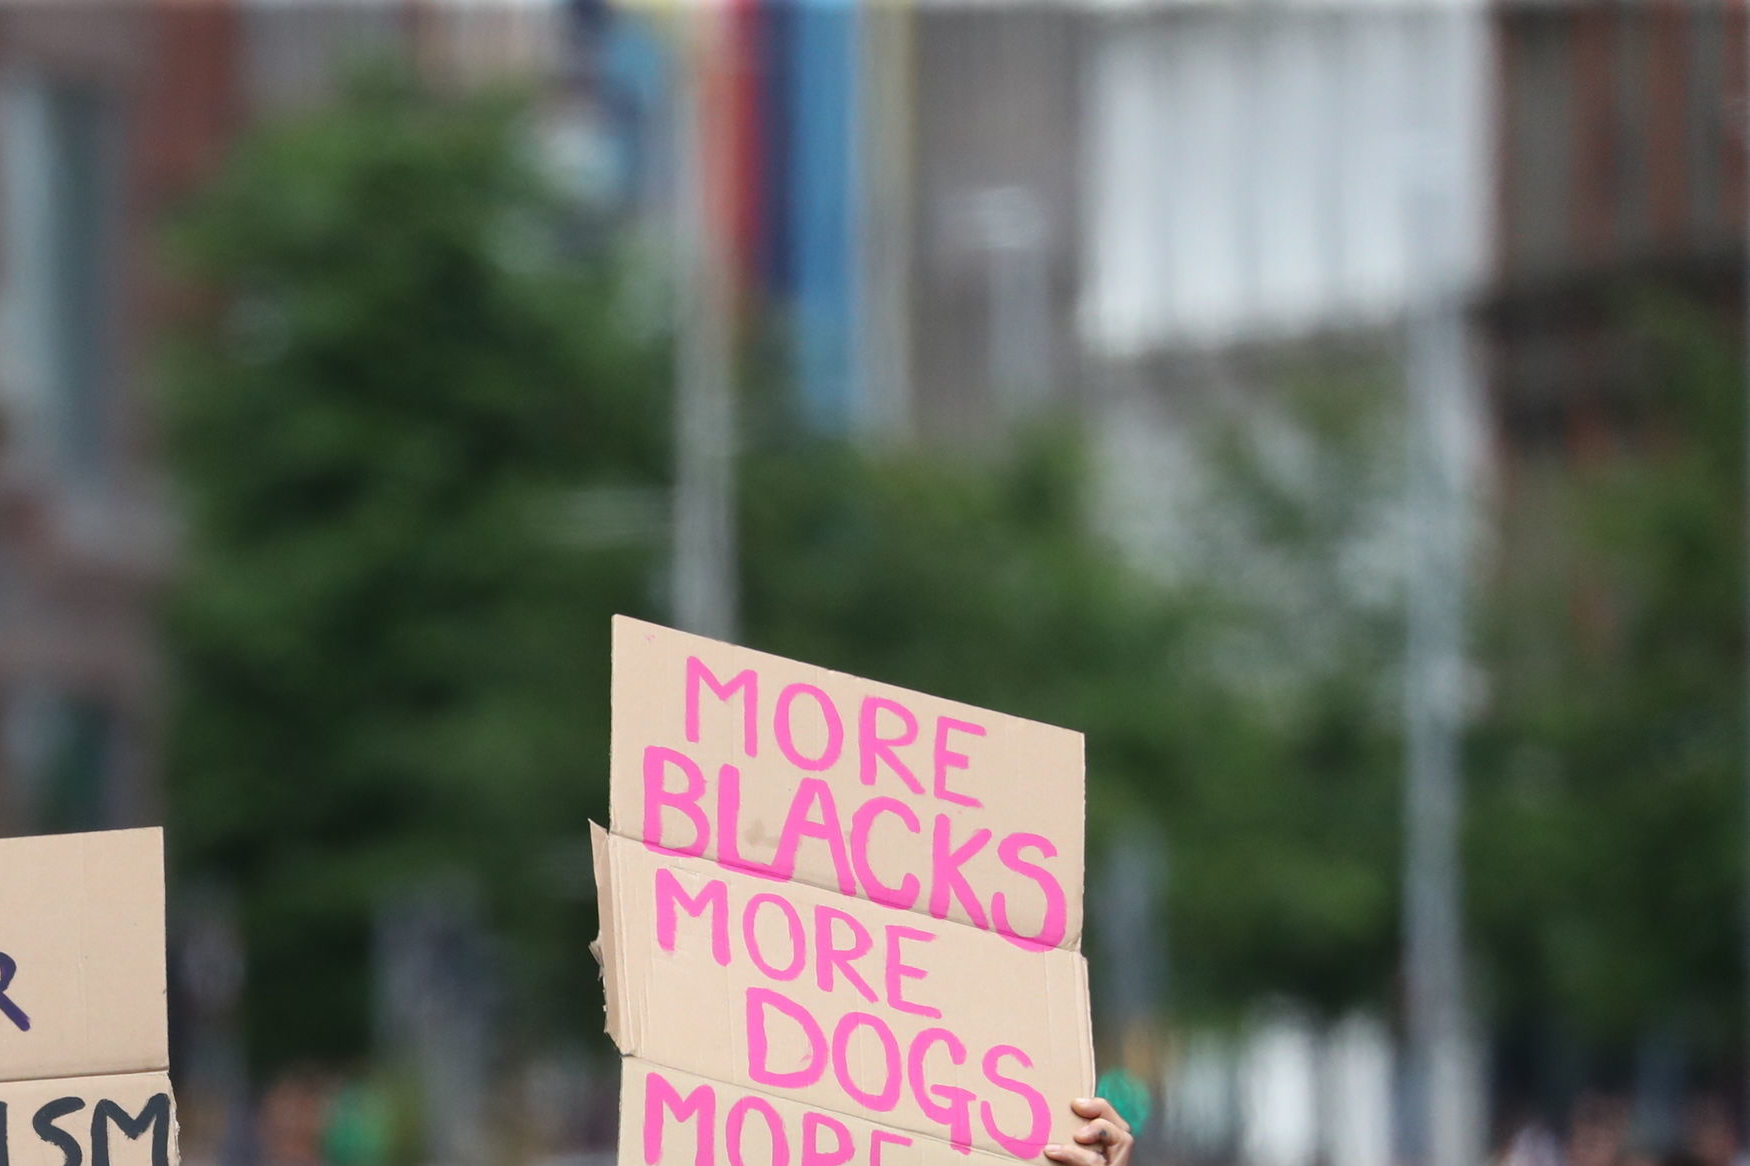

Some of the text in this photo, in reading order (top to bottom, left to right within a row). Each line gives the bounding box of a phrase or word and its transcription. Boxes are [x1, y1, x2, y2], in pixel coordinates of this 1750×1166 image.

[685, 655, 987, 809] MORE
[641, 745, 1067, 953] BLACKS
[655, 868, 943, 1019] MORE
[745, 986, 1052, 1160] DOGS
